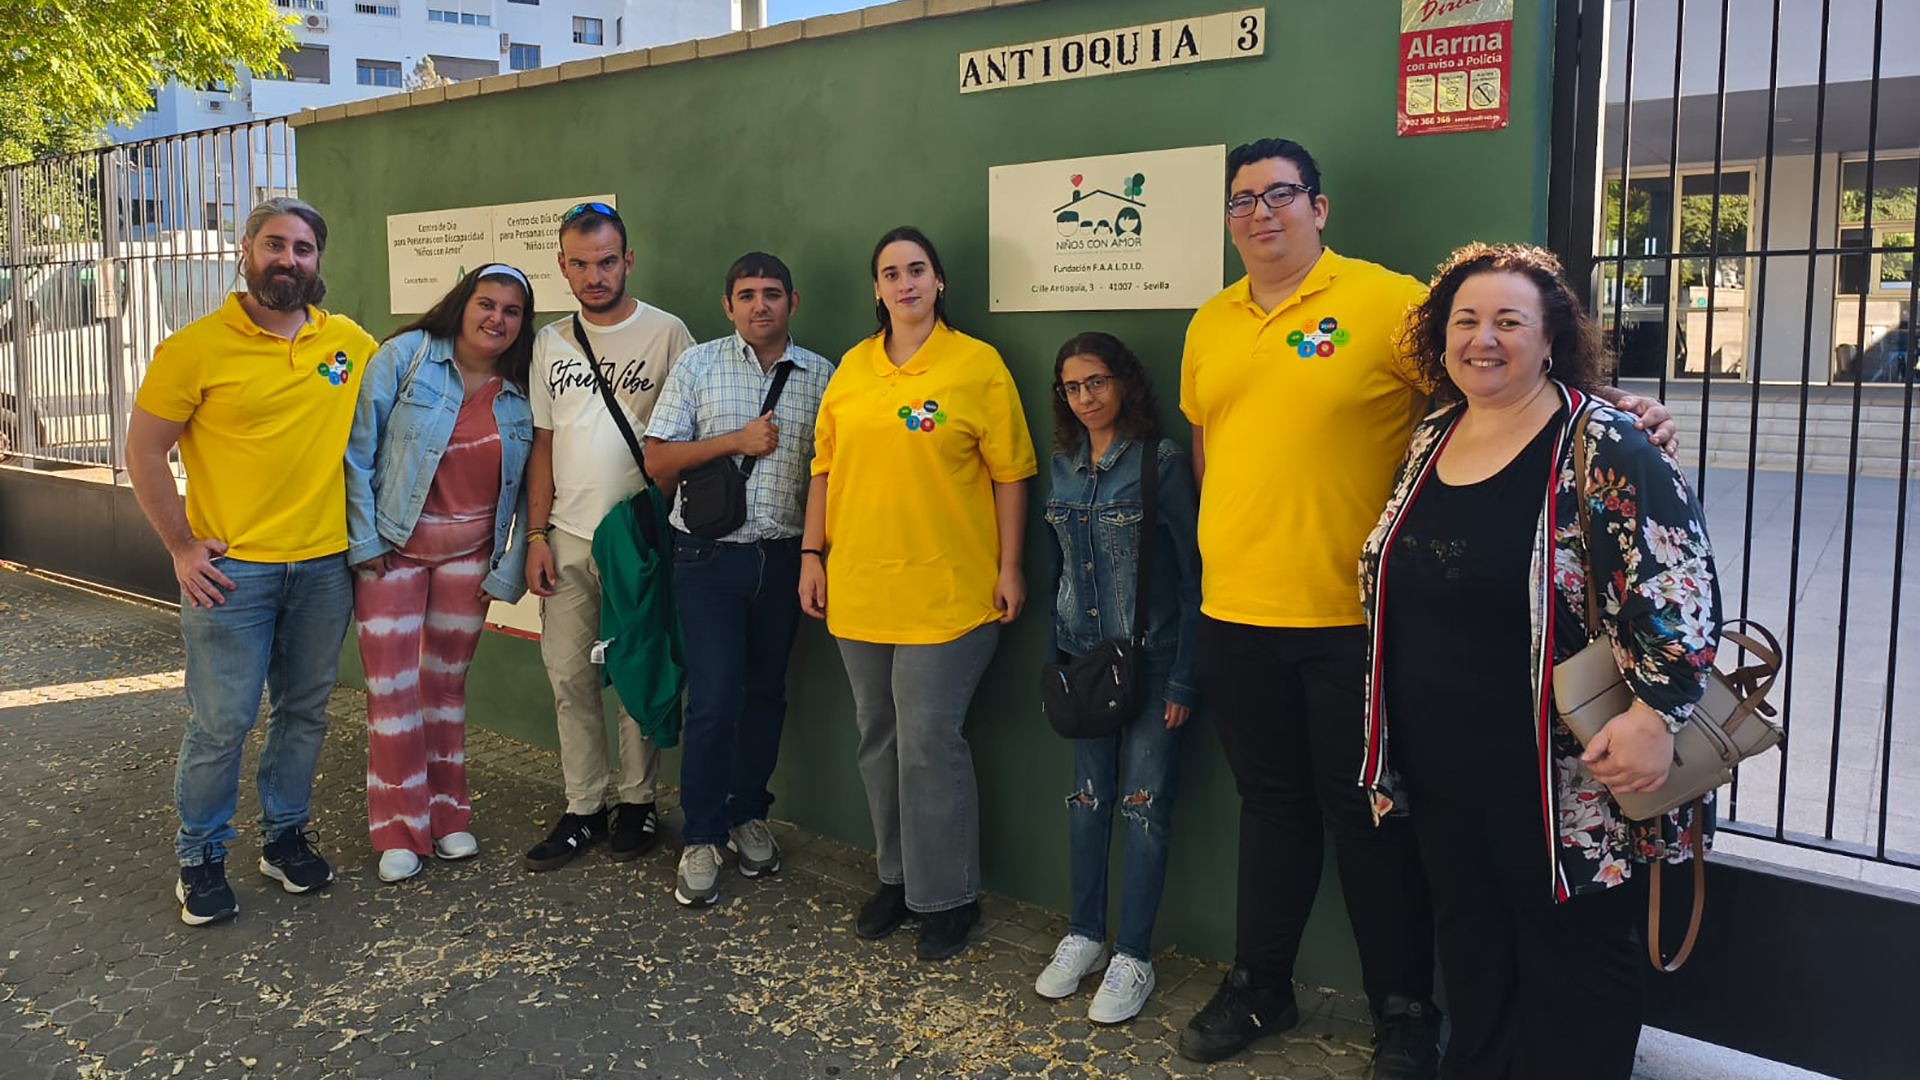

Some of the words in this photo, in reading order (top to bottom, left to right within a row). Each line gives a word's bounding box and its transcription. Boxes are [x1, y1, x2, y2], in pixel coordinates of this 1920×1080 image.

[961, 24, 1199, 88] ANTIOQUIA
[1237, 15, 1259, 51] 3
[1407, 32, 1503, 60] Alarma
[1406, 62, 1425, 72] con
[1427, 58, 1455, 69] aviso
[1457, 59, 1464, 67] a
[438, 222, 446, 231] de
[507, 216, 530, 227] Centro
[530, 214, 540, 225] de
[433, 235, 444, 244] con
[444, 231, 485, 243] Discapacidad
[500, 231, 514, 242] para
[515, 229, 545, 239] Personas
[1056, 239, 1084, 250] NIÑOS
[1087, 239, 1108, 249] CON
[1111, 237, 1142, 248] AMOR
[1054, 264, 1091, 274] Fundación
[1089, 283, 1095, 292] 3
[1108, 282, 1133, 292] 41007
[1143, 281, 1170, 291] Sevilla
[604, 359, 655, 396] Vibe
